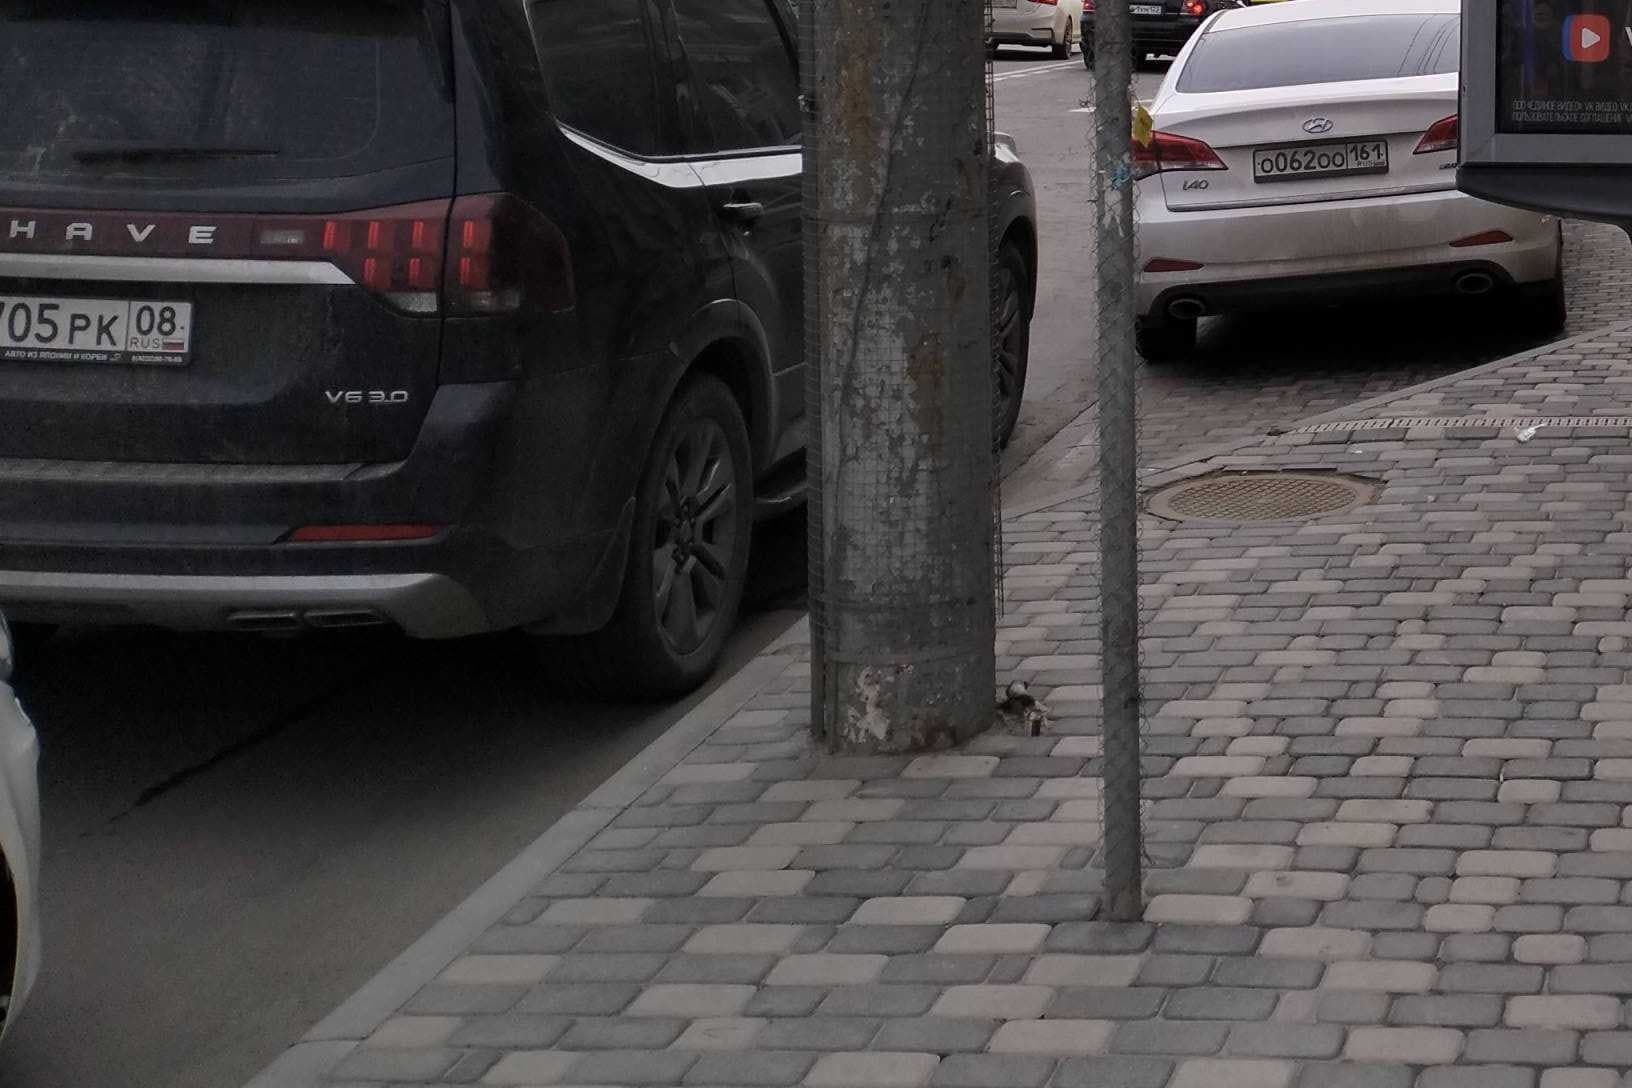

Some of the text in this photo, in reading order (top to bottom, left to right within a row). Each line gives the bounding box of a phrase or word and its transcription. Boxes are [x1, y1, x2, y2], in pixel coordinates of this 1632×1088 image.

[1349, 143, 1381, 161] 161
[9, 220, 217, 244] HAVE
[136, 305, 176, 337] 08
[130, 337, 160, 349] RUS
[325, 390, 362, 403] V6
